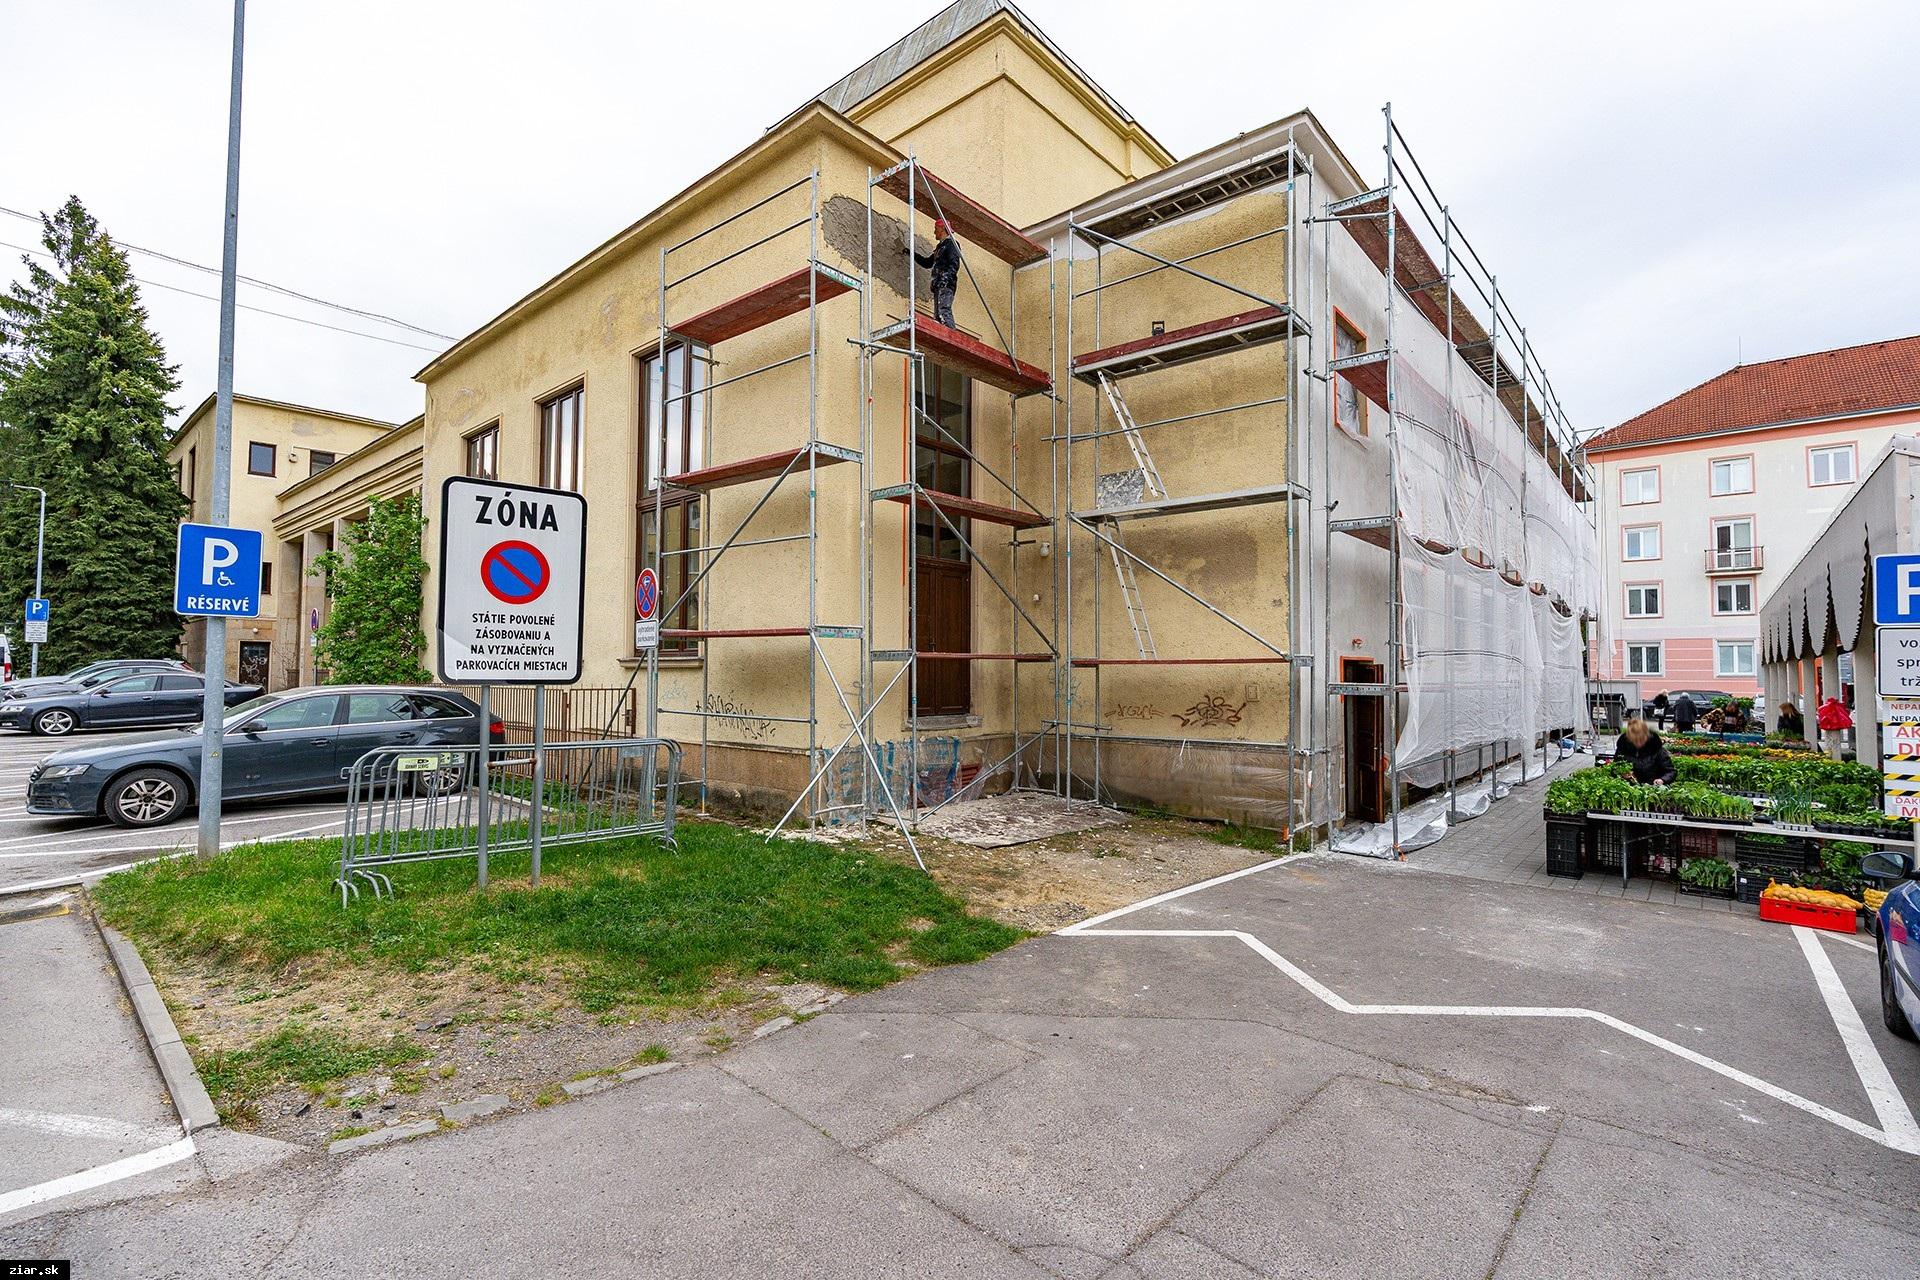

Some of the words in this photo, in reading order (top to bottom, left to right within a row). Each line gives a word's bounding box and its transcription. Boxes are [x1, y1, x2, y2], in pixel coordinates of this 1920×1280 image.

[475, 491, 559, 532] ZÓNA
[202, 537, 239, 586] P
[32, 602, 43, 614] P
[187, 594, 249, 612] RÉSERVÉ
[472, 611, 506, 624] STÁTIE
[510, 614, 555, 626] POVOLENÉ
[475, 626, 541, 640] ZÁSOBOVANIU
[544, 631, 551, 640] A
[470, 644, 485, 655] NA
[488, 643, 555, 656] VYZNAČENÝCH
[1899, 640, 1920, 648] vo
[456, 658, 520, 670] PARKOVACÍCH
[523, 661, 568, 671] MIESTACH
